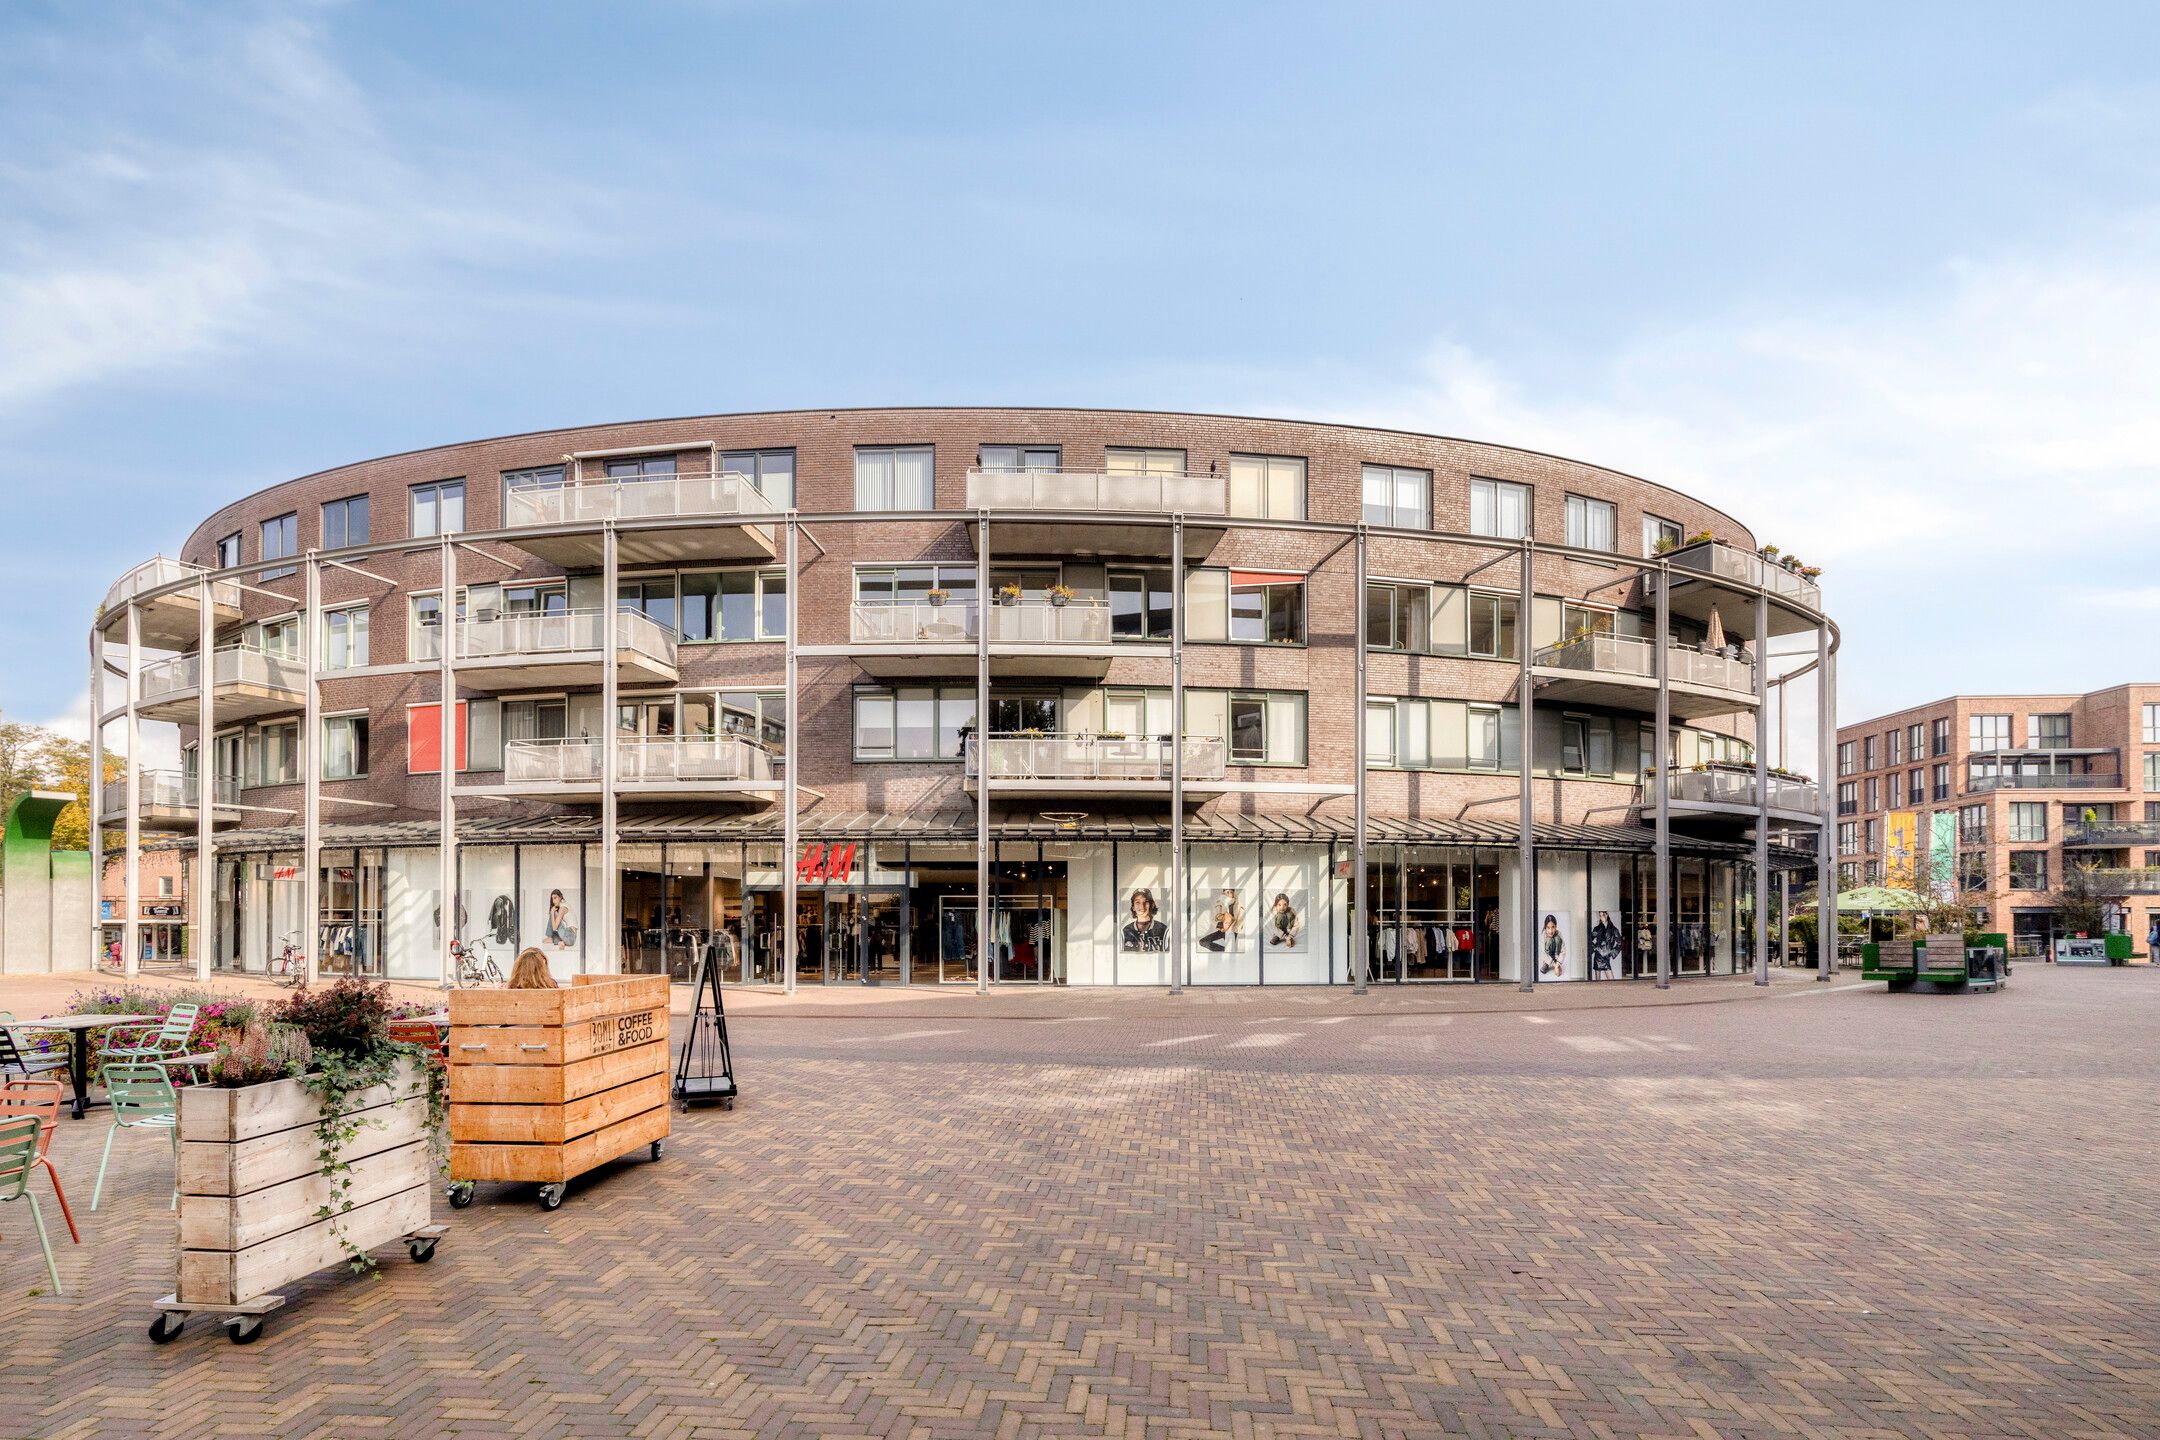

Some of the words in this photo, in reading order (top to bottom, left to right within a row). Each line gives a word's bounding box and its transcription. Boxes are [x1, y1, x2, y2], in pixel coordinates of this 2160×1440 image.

[796, 842, 856, 884] H&M
[618, 1012, 653, 1032] COFFEE
[618, 1026, 653, 1047] &FOOD
